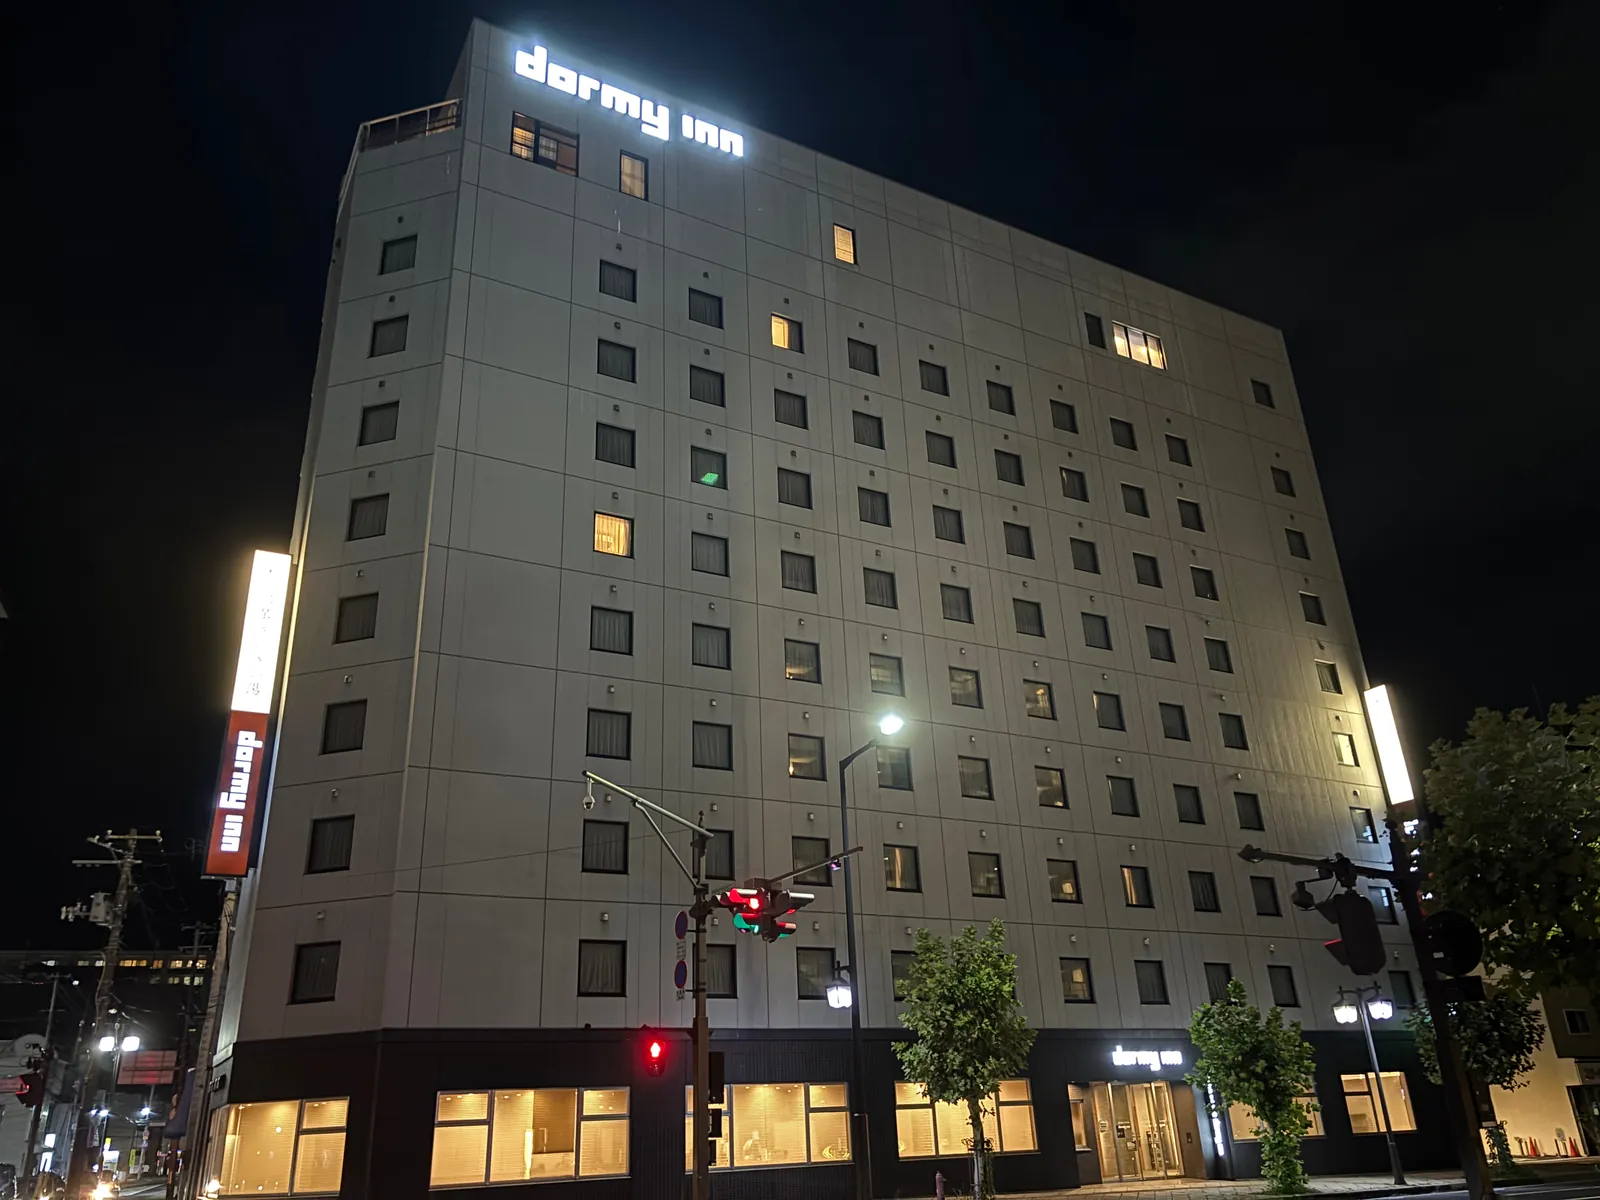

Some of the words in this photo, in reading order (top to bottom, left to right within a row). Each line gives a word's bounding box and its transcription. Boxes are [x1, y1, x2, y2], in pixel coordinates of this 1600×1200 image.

[515, 45, 670, 141] dormy
[681, 114, 744, 157] inn
[219, 730, 263, 810] dormy
[220, 814, 244, 852] inn
